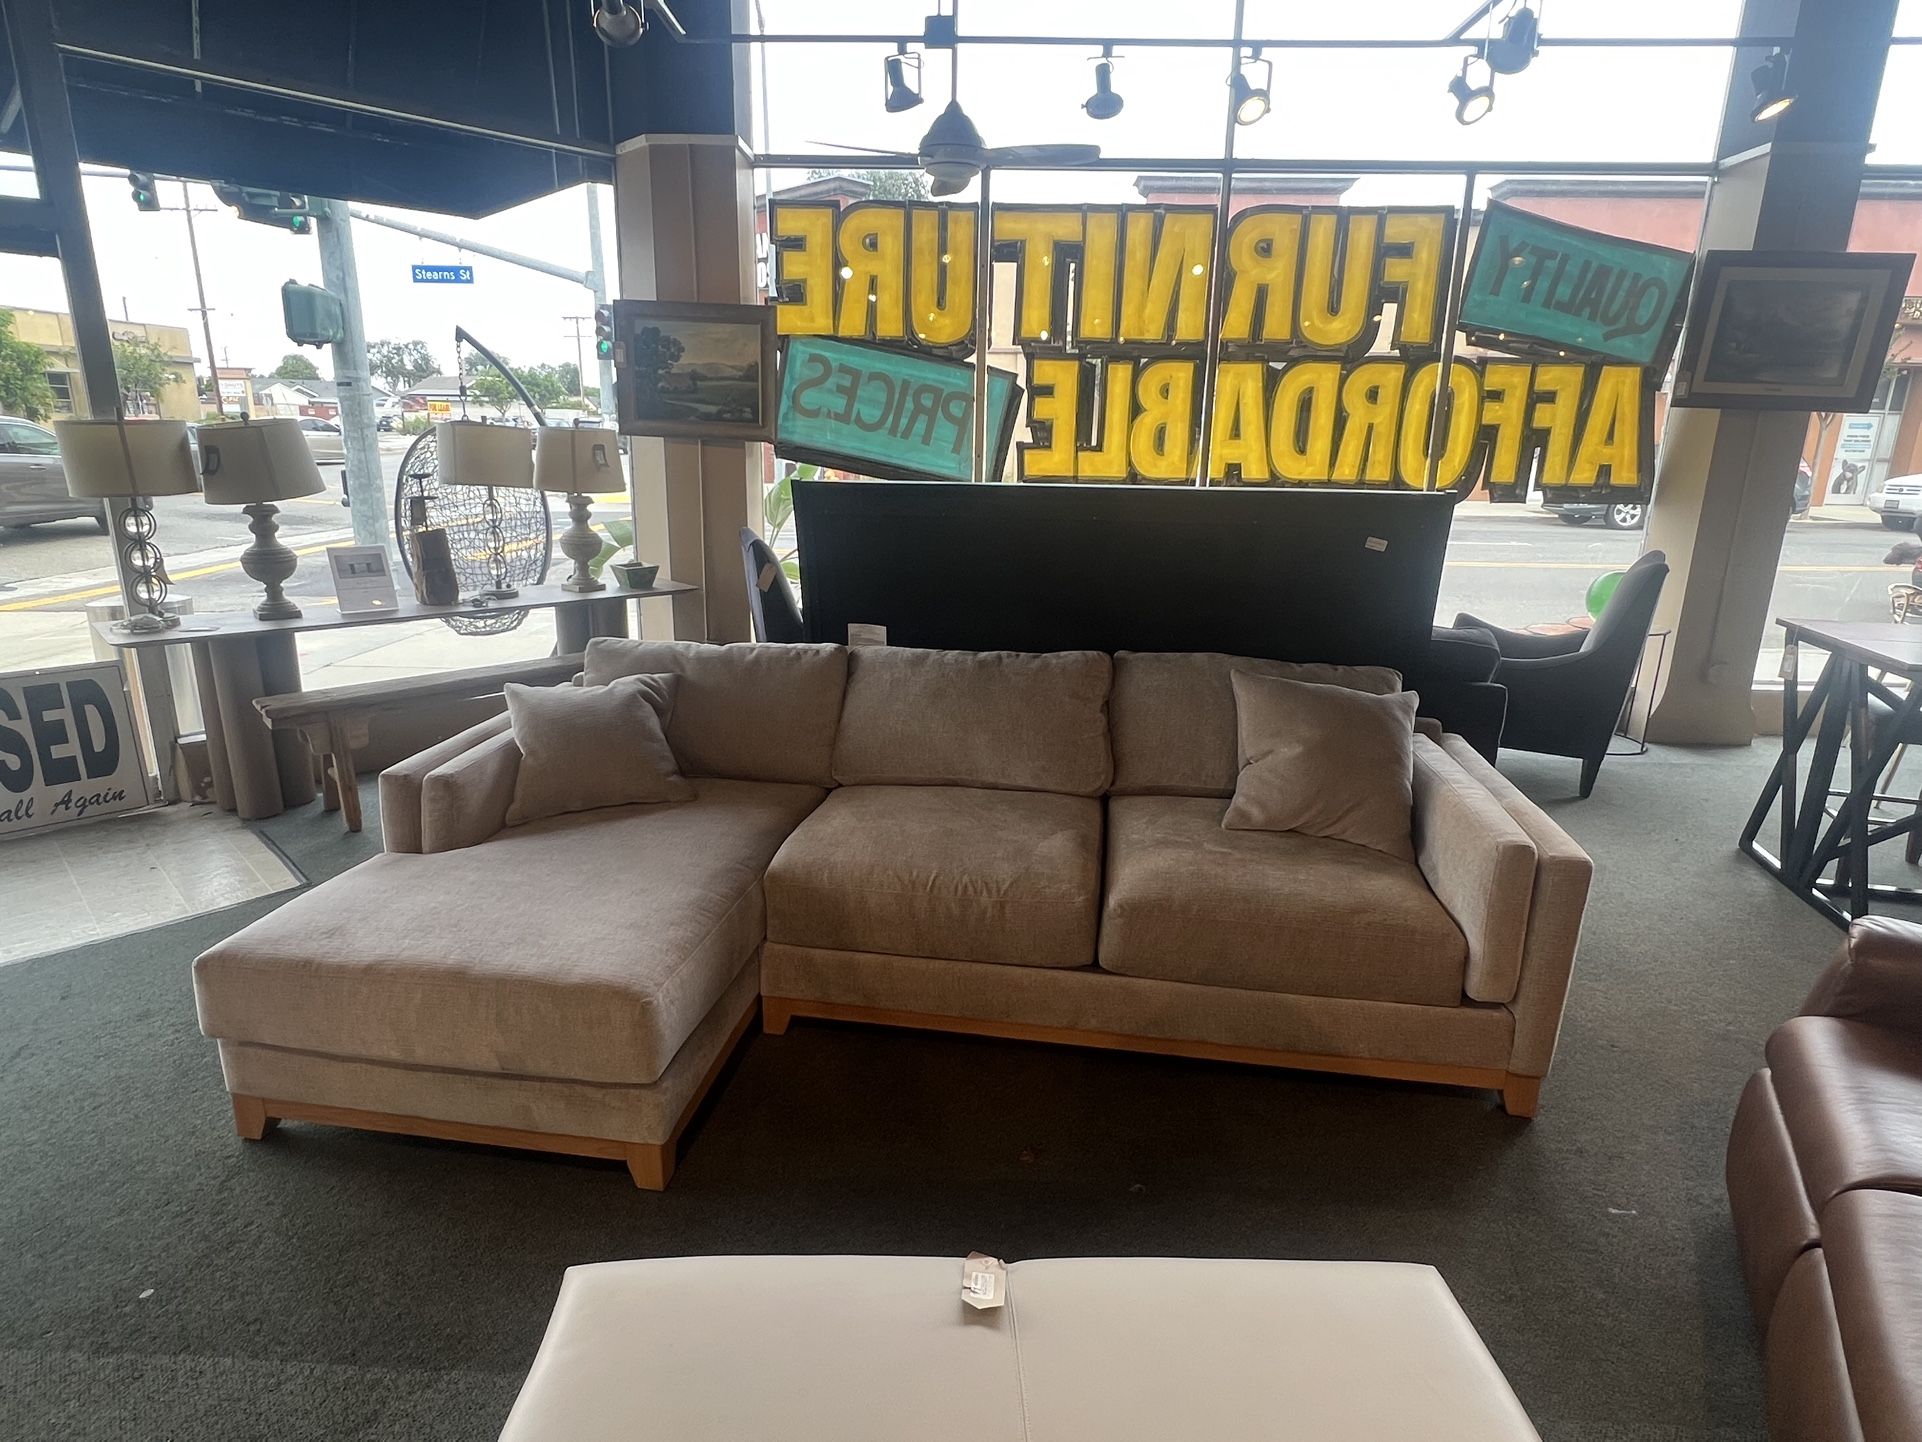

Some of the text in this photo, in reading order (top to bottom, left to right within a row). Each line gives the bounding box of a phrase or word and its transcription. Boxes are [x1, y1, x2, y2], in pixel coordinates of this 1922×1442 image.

[415, 268, 471, 280] Stearns St
[51, 787, 126, 817] Again
